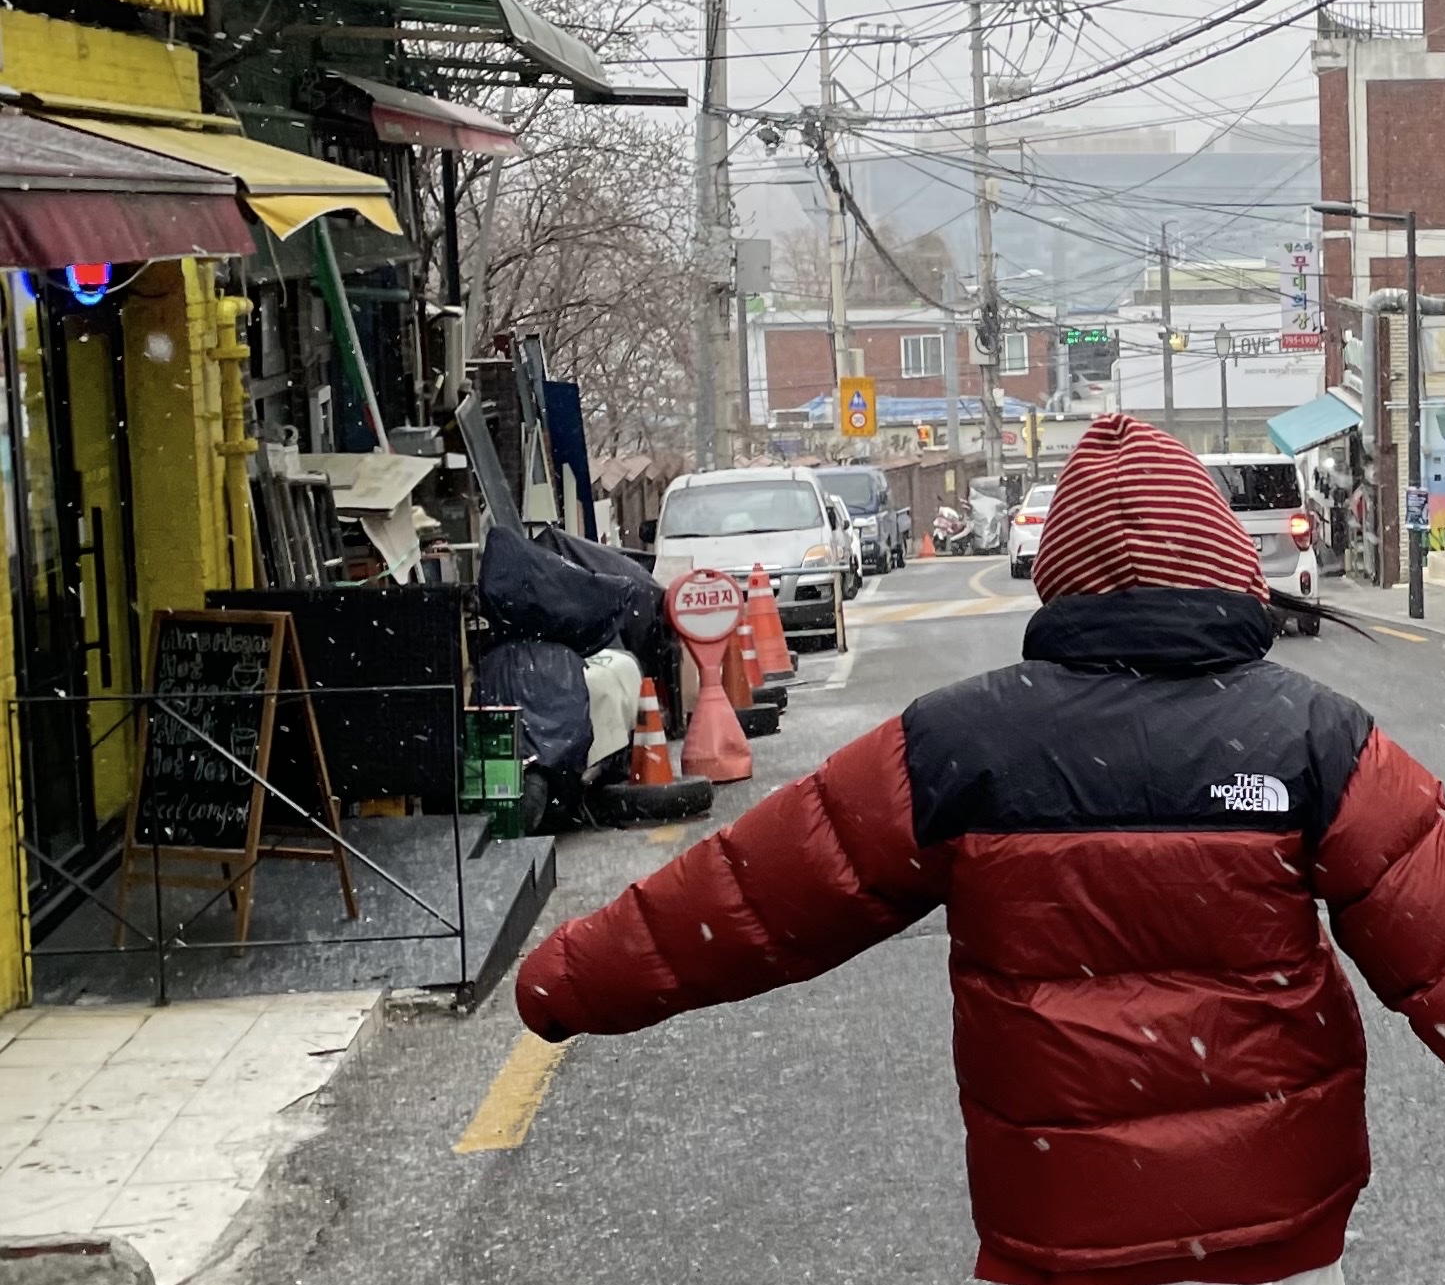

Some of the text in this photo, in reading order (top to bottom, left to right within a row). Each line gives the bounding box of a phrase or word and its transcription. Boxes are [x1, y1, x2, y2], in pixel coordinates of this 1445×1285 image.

[1234, 773, 1263, 786] THE
[1210, 784, 1262, 798] NORTH
[1225, 797, 1263, 811] FACE
